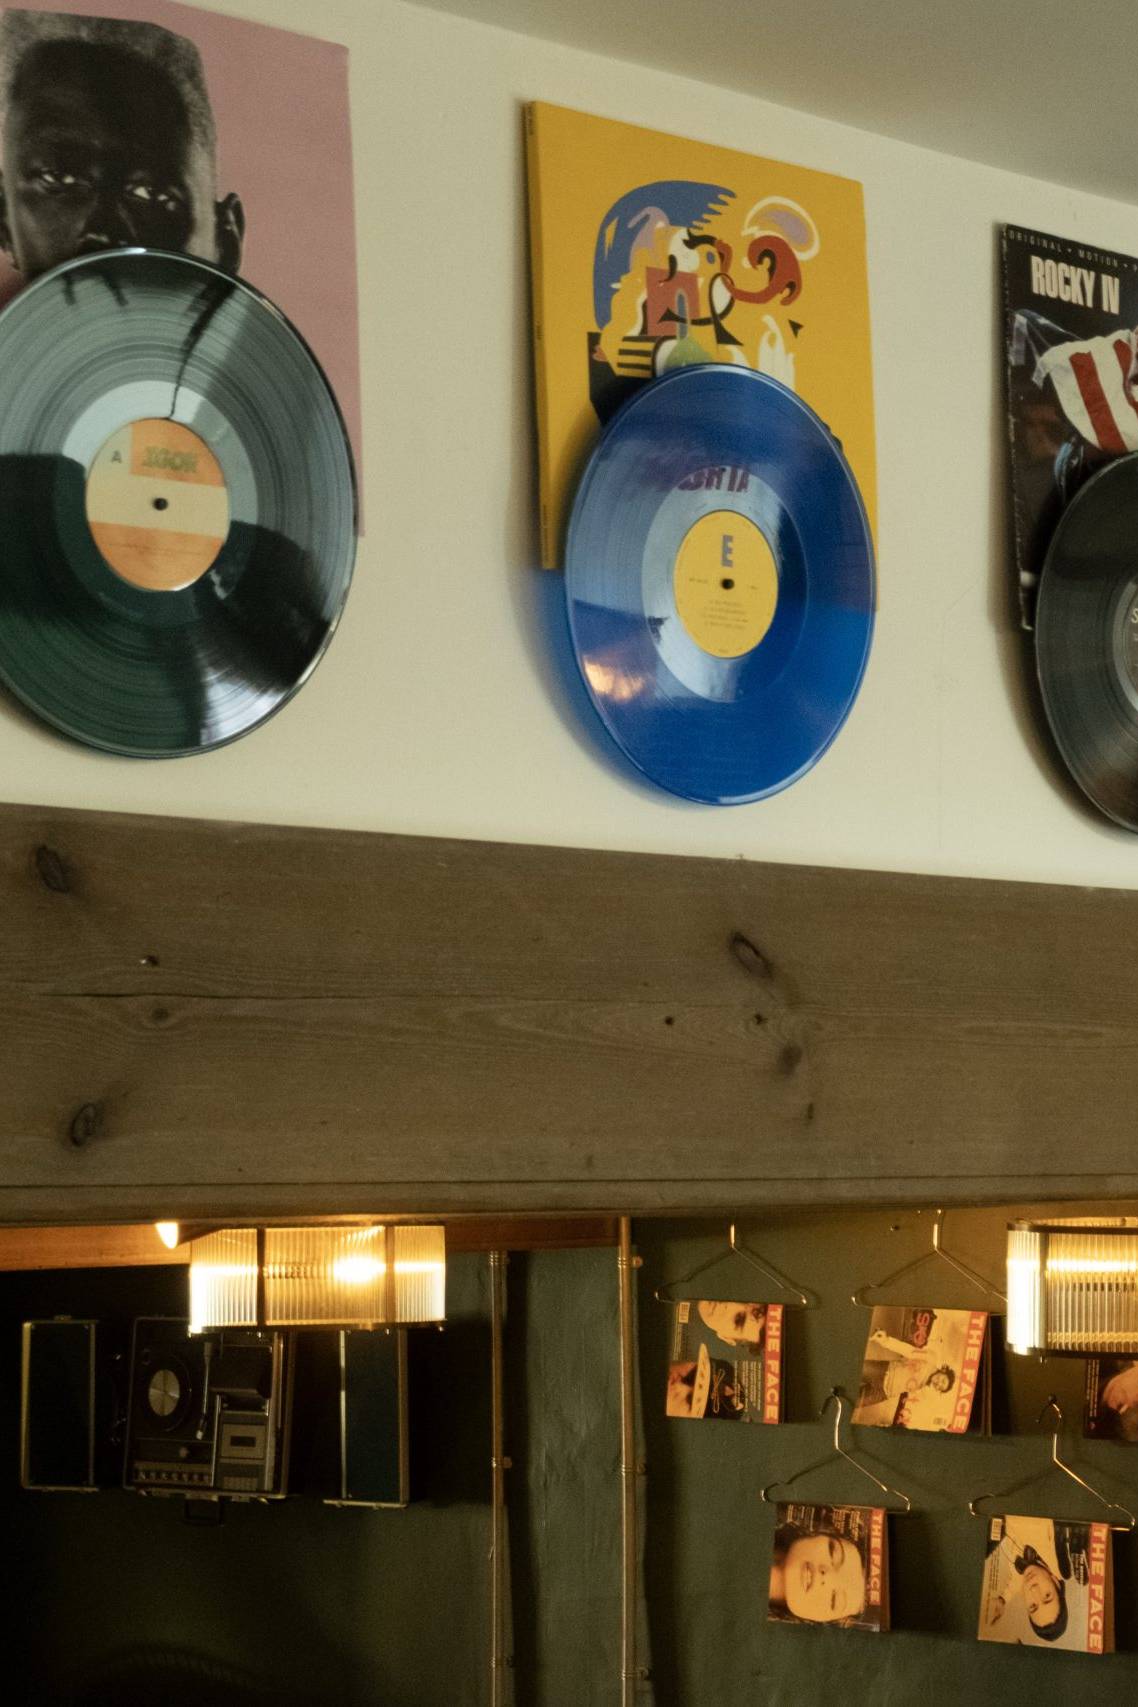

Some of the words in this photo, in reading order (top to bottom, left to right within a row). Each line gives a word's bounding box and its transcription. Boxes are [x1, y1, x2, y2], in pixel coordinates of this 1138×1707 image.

[1030, 254, 1096, 308] ROCKY
[1102, 275, 1120, 315] IV
[721, 534, 734, 568] E
[767, 1307, 783, 1352] THE
[965, 1314, 987, 1361] THE
[765, 1359, 780, 1418] FACE
[953, 1368, 978, 1430] FACE
[870, 1511, 882, 1547] THE
[1091, 1526, 1108, 1576] THE
[870, 1554, 881, 1602] FACE
[1089, 1584, 1105, 1648] FACE
